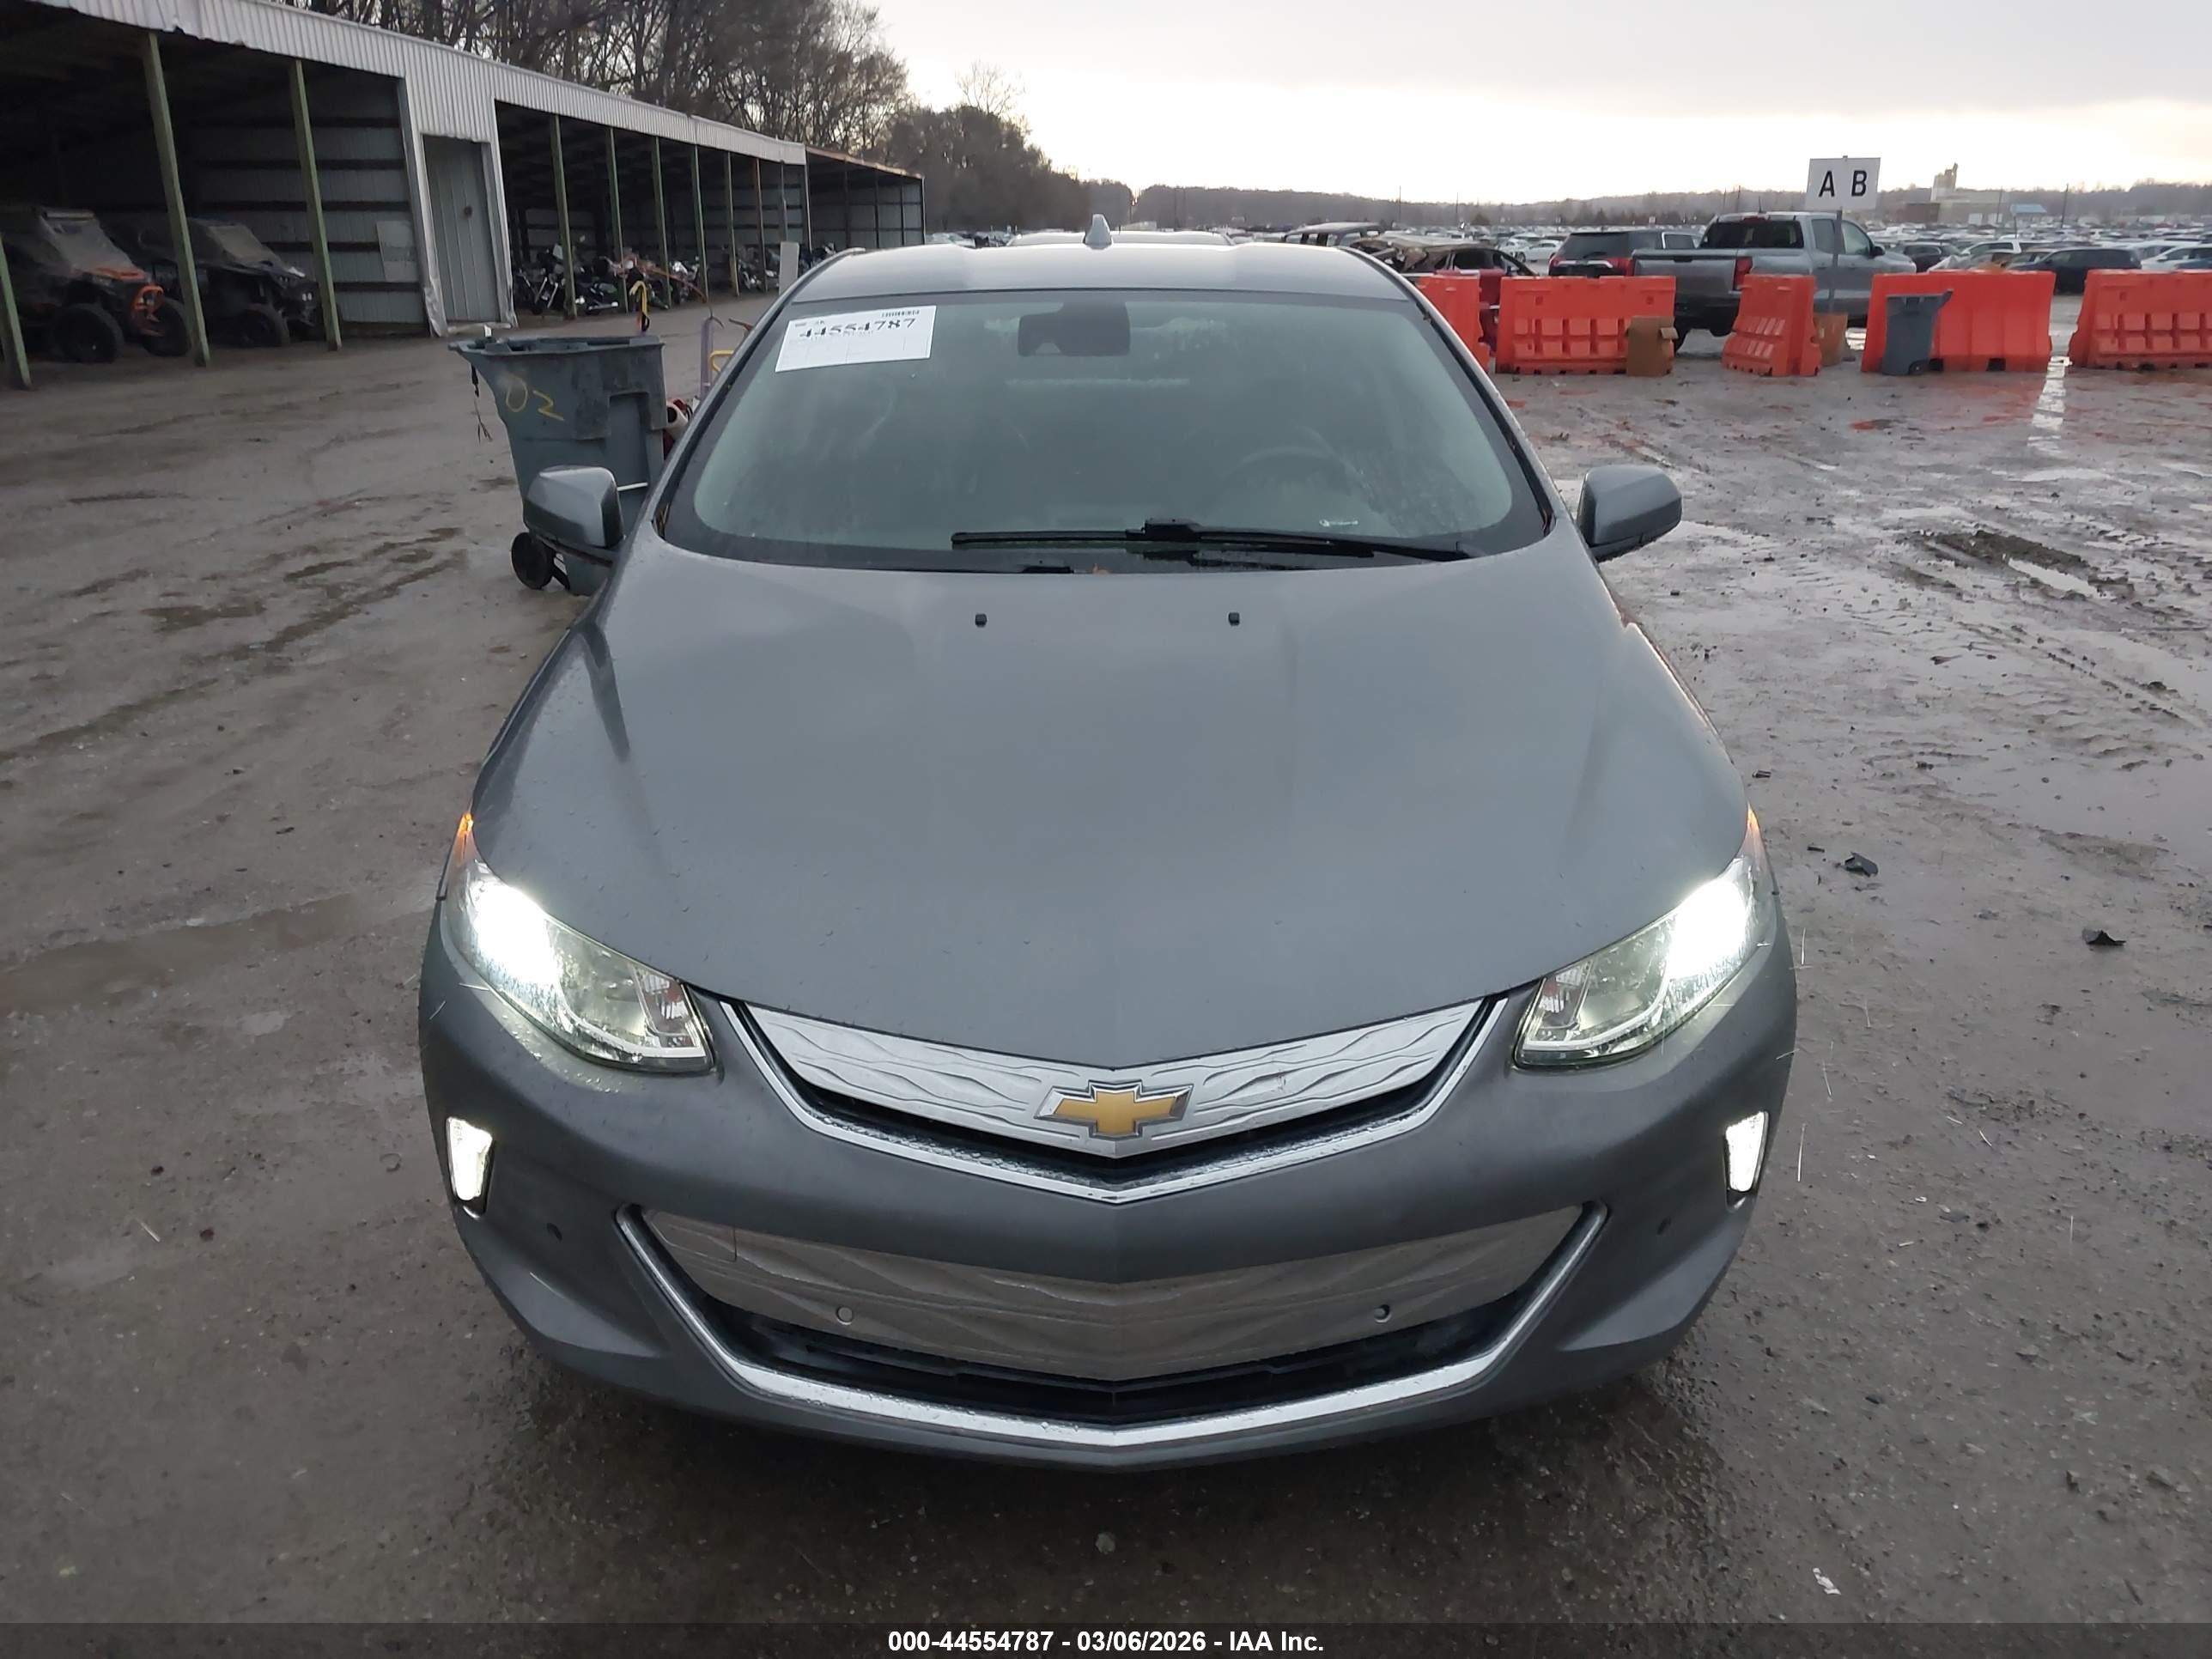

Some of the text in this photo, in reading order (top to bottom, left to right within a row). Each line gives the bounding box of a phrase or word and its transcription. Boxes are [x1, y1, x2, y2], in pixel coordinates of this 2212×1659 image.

[1818, 169, 1868, 198] A B
[799, 318, 916, 338] 44554787
